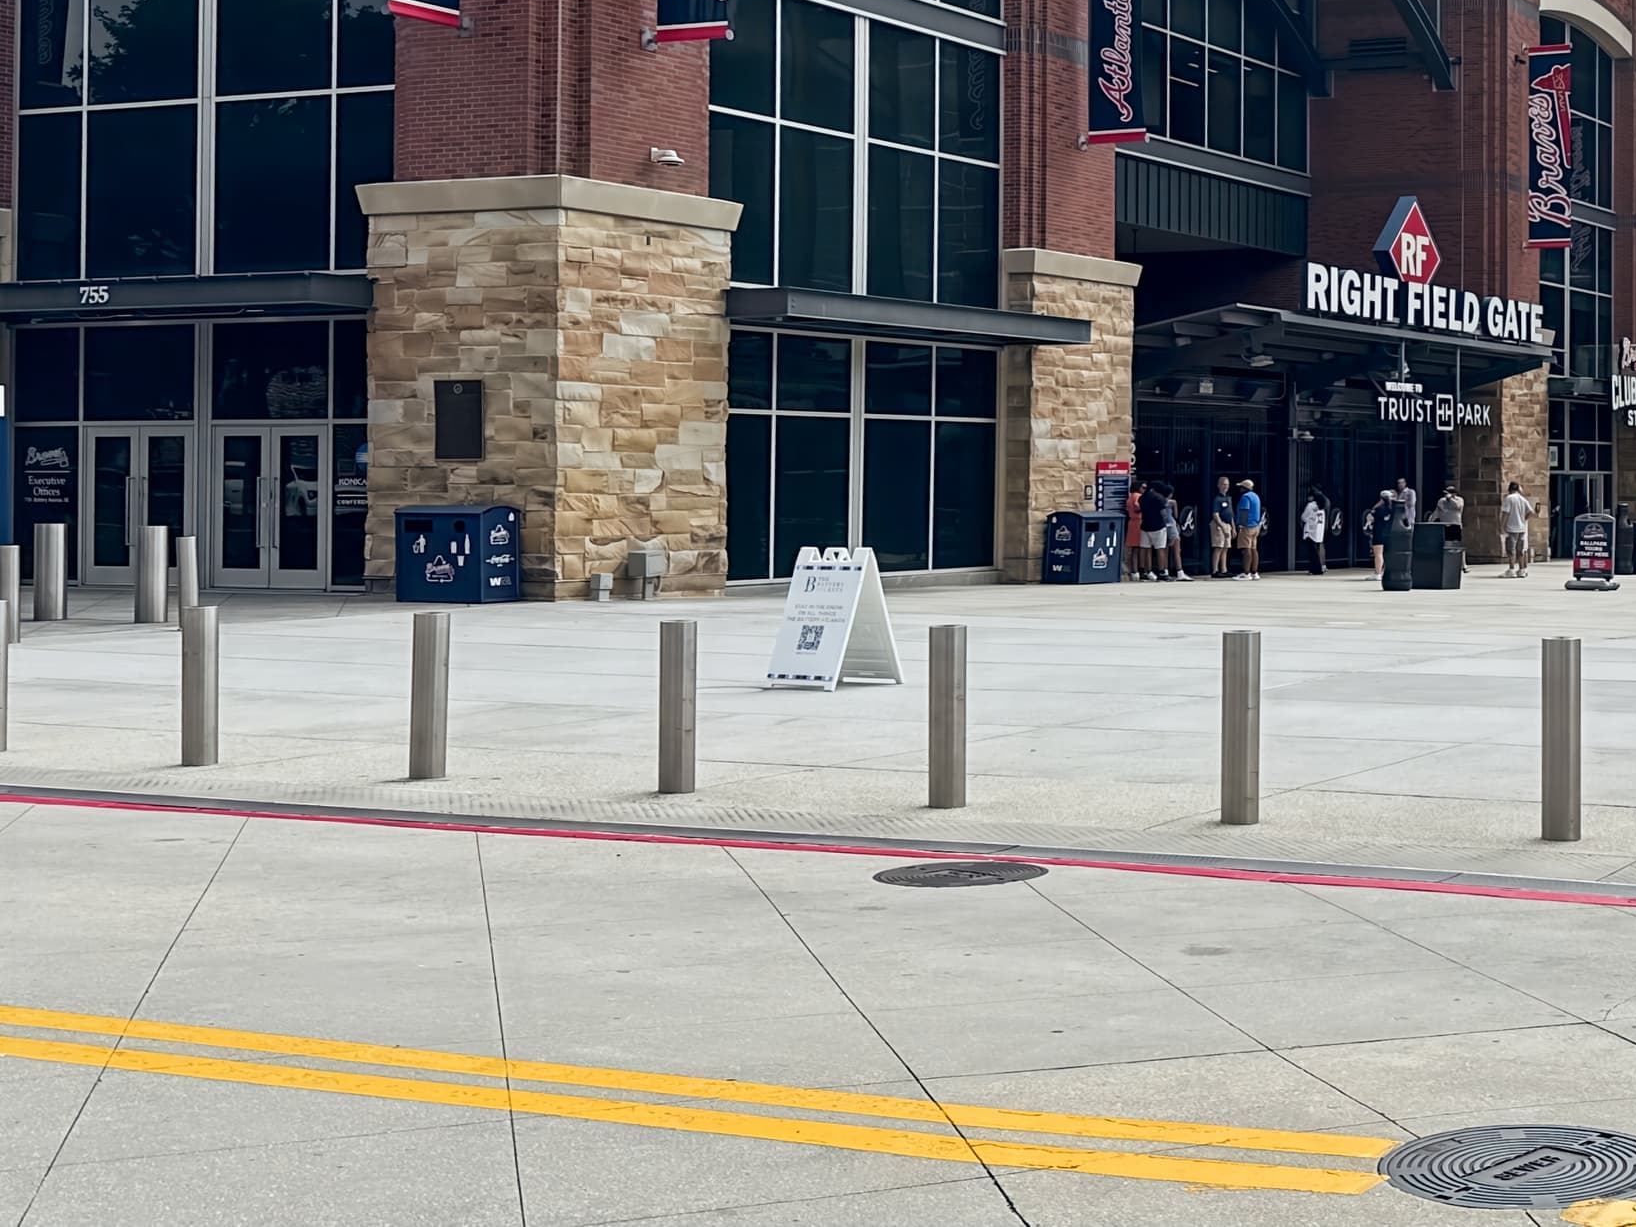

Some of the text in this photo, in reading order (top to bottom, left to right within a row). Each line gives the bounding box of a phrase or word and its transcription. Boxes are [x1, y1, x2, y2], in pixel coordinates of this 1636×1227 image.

[1528, 92, 1572, 229] Braves
[1400, 232, 1430, 277] RF
[79, 285, 110, 304] 755
[1307, 261, 1545, 343] RIGHT FIELD GATE
[1377, 396, 1492, 427] TRUIST PARK
[28, 475, 67, 486] Executive
[33, 486, 60, 497] Offices
[338, 477, 368, 486] KONICA
[1493, 1155, 1563, 1181] SEWER
